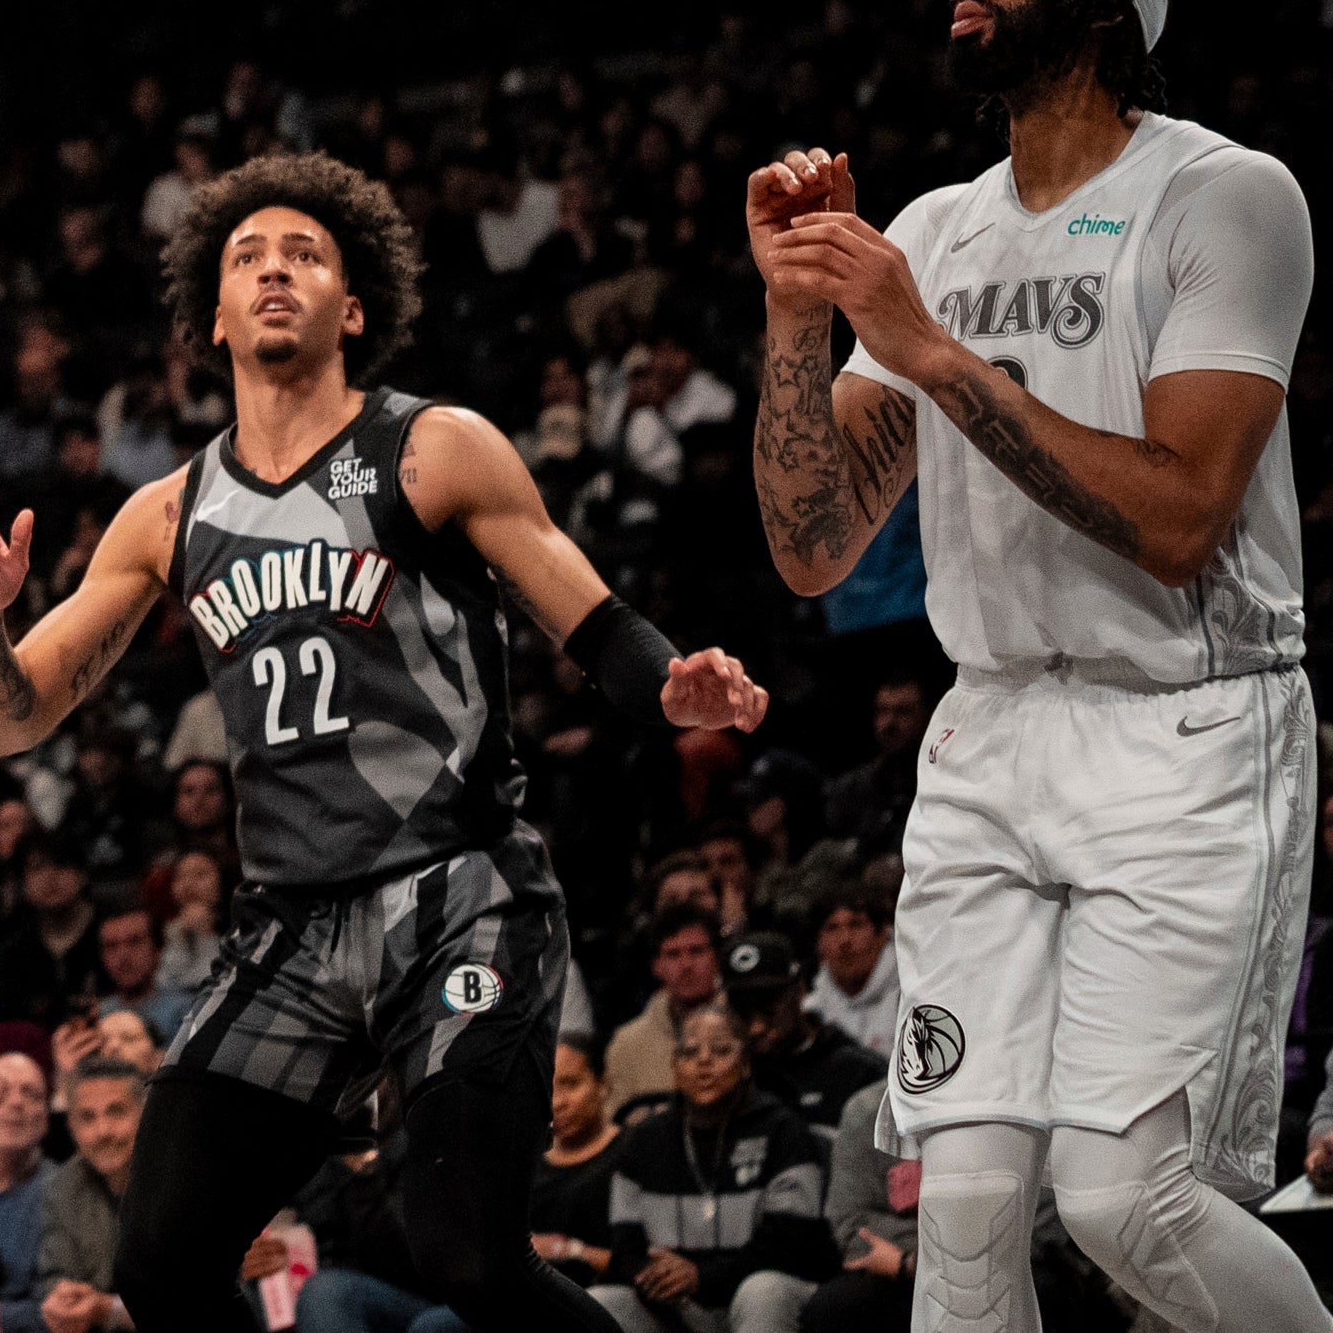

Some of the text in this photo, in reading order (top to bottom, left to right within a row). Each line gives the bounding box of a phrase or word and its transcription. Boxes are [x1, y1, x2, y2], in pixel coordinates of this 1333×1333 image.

[1067, 214, 1126, 236] chime
[936, 272, 1106, 350] MAVS
[330, 458, 362, 474] GET
[330, 468, 377, 486] YOUR
[328, 480, 378, 499] GUIDE
[189, 541, 390, 651] BROOKLYN
[252, 637, 350, 745] 22
[463, 970, 482, 1004] B
